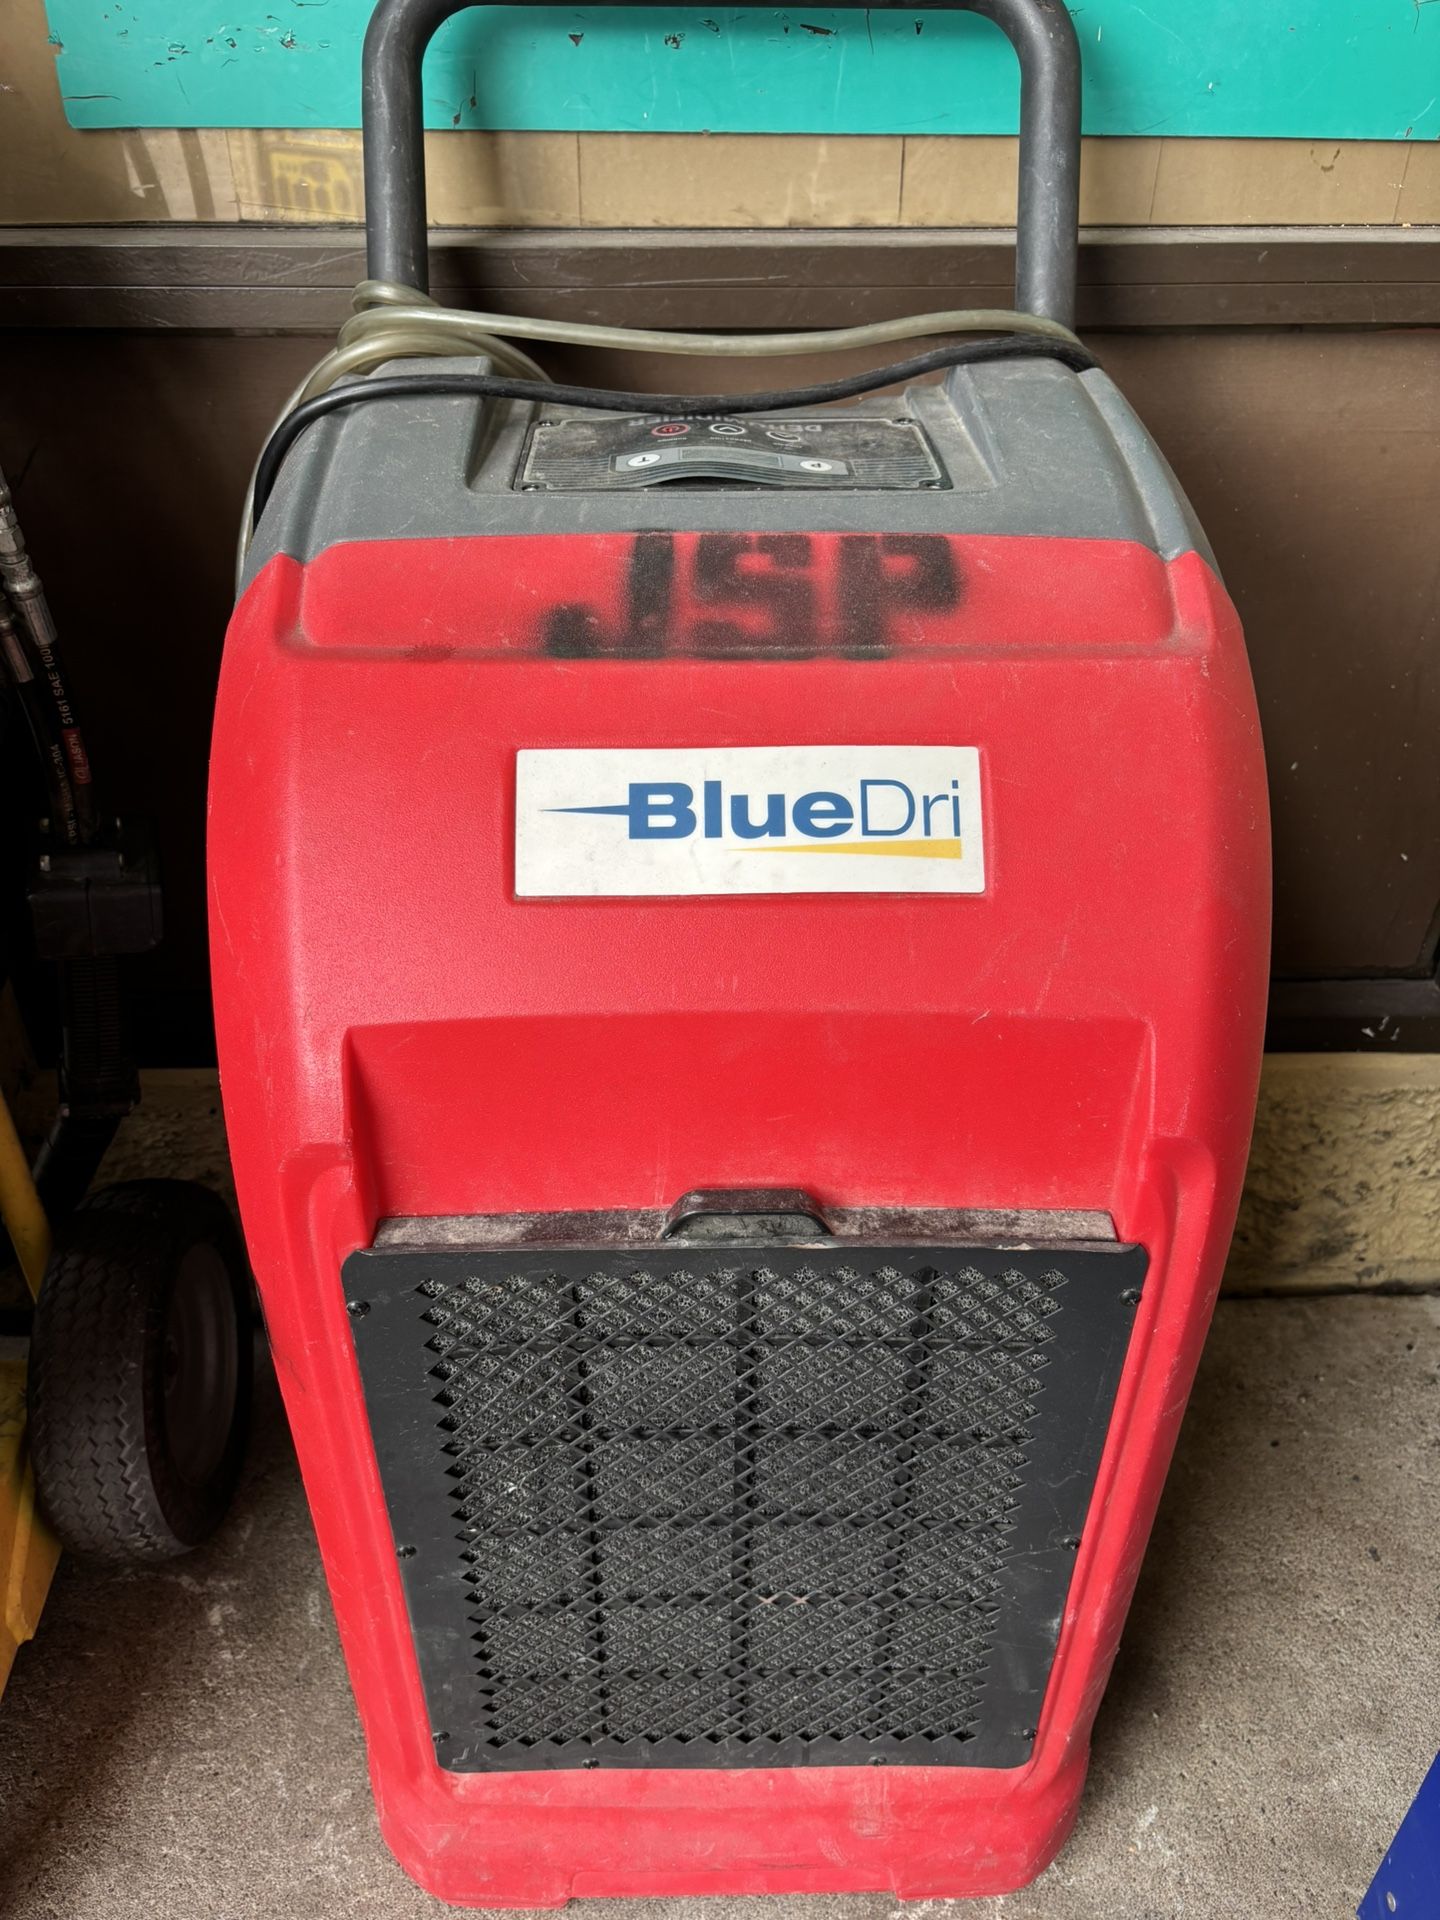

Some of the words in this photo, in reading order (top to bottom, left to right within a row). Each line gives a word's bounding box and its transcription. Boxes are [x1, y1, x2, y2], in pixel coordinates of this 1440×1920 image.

[545, 529, 964, 660] JSP
[48, 671, 64, 696] SAE
[56, 699, 74, 724] 5161
[628, 779, 961, 839] BlueDri
